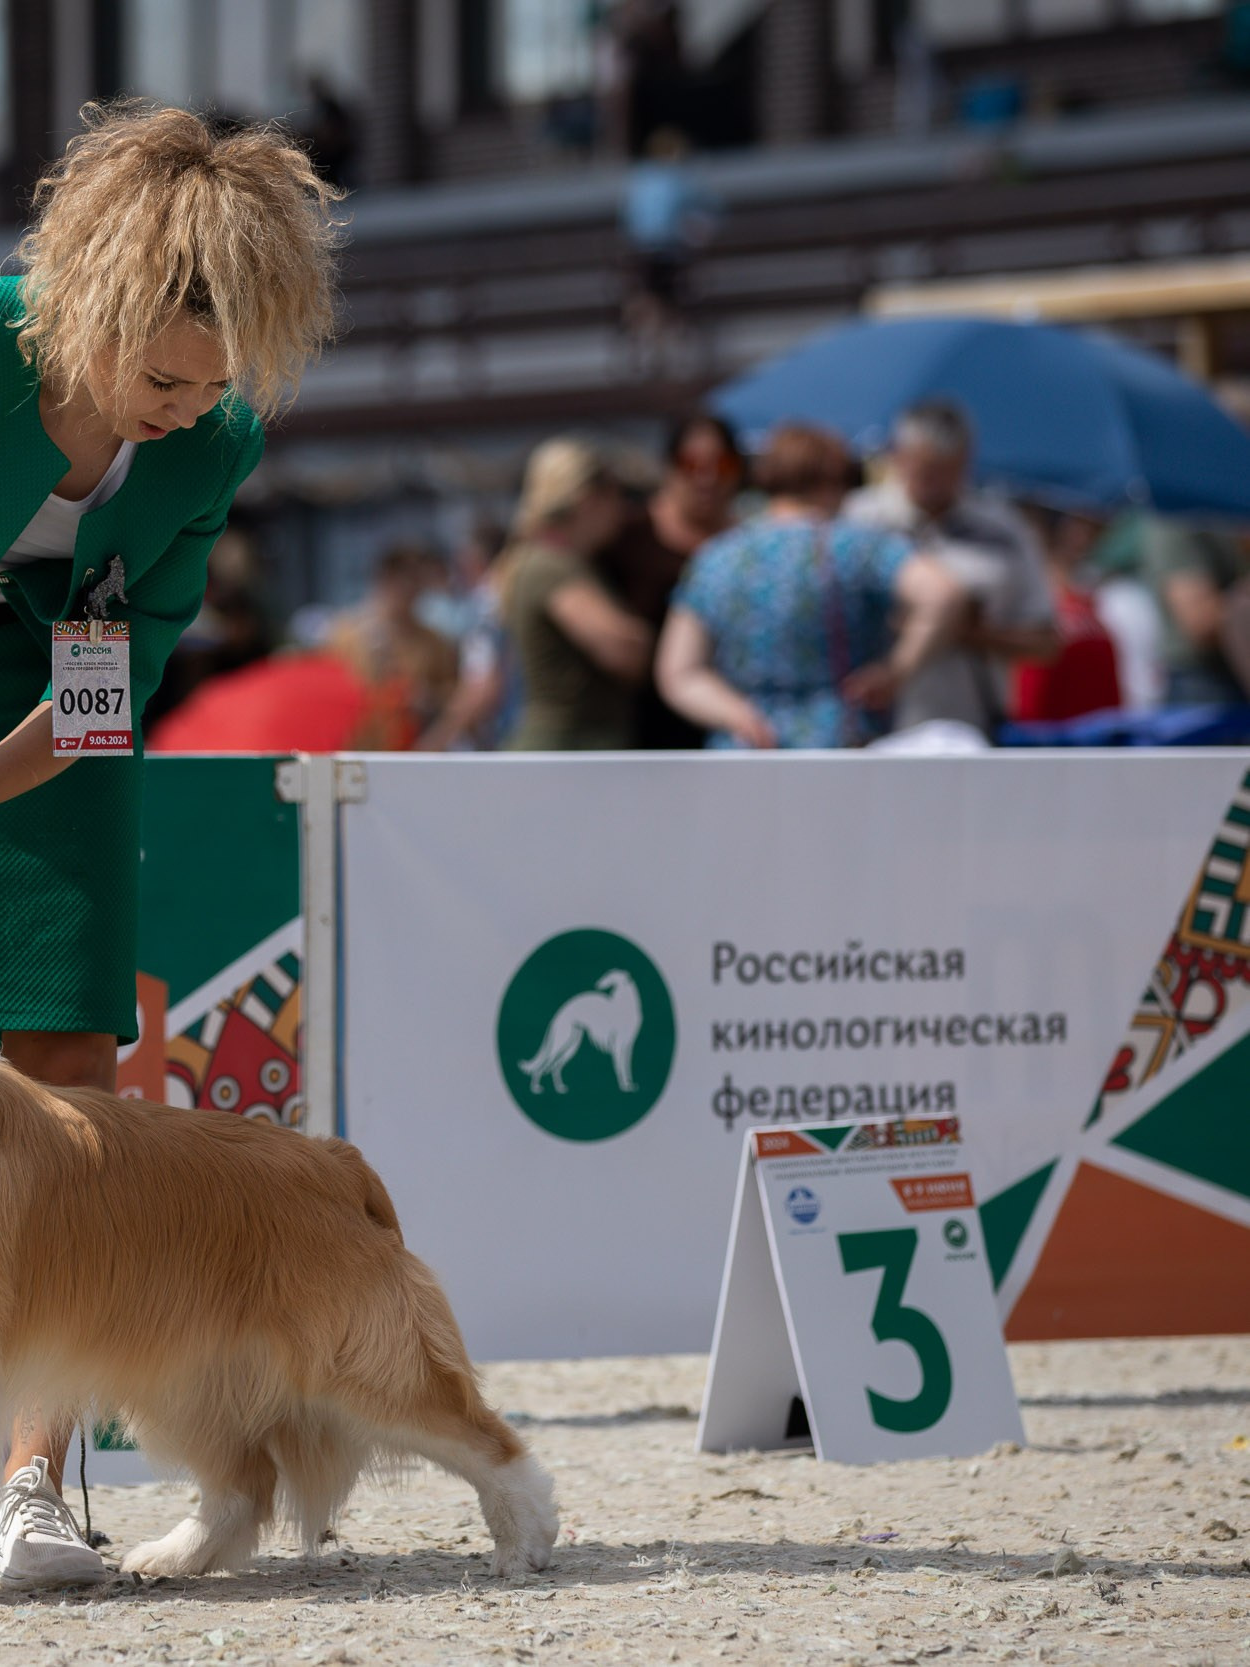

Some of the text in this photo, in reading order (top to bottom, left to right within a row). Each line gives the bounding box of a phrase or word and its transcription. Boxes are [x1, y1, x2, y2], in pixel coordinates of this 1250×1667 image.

[82, 646, 112, 655] РОССИЯ
[59, 688, 125, 716] 0087
[89, 735, 128, 745] 9.06.2024
[712, 939, 966, 986] Российская
[711, 1012, 1068, 1051] кинологическая
[711, 1073, 956, 1132] федерация
[836, 1225, 954, 1434] 3
